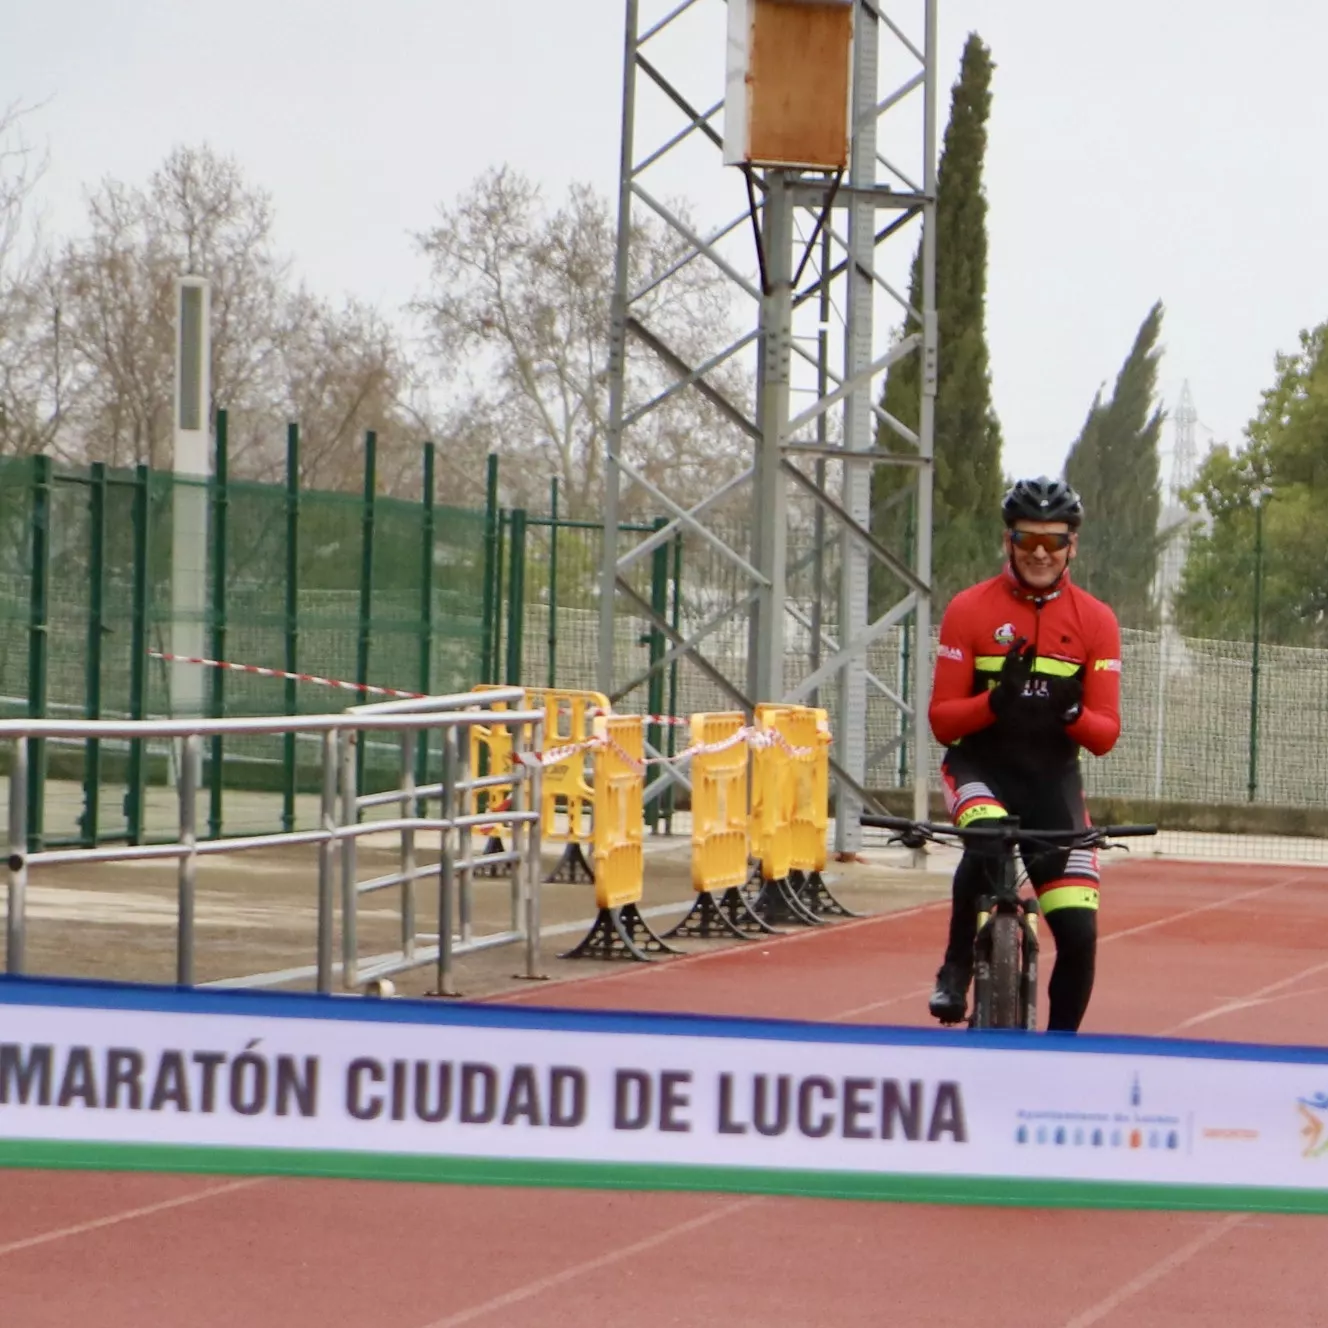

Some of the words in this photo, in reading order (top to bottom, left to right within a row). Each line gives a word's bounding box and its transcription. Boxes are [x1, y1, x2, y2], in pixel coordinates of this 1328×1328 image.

[0, 1038, 319, 1118] MARATÓN
[345, 1056, 589, 1129] CIUDAD
[614, 1068, 693, 1133] DE
[718, 1071, 968, 1143] LUCENA
